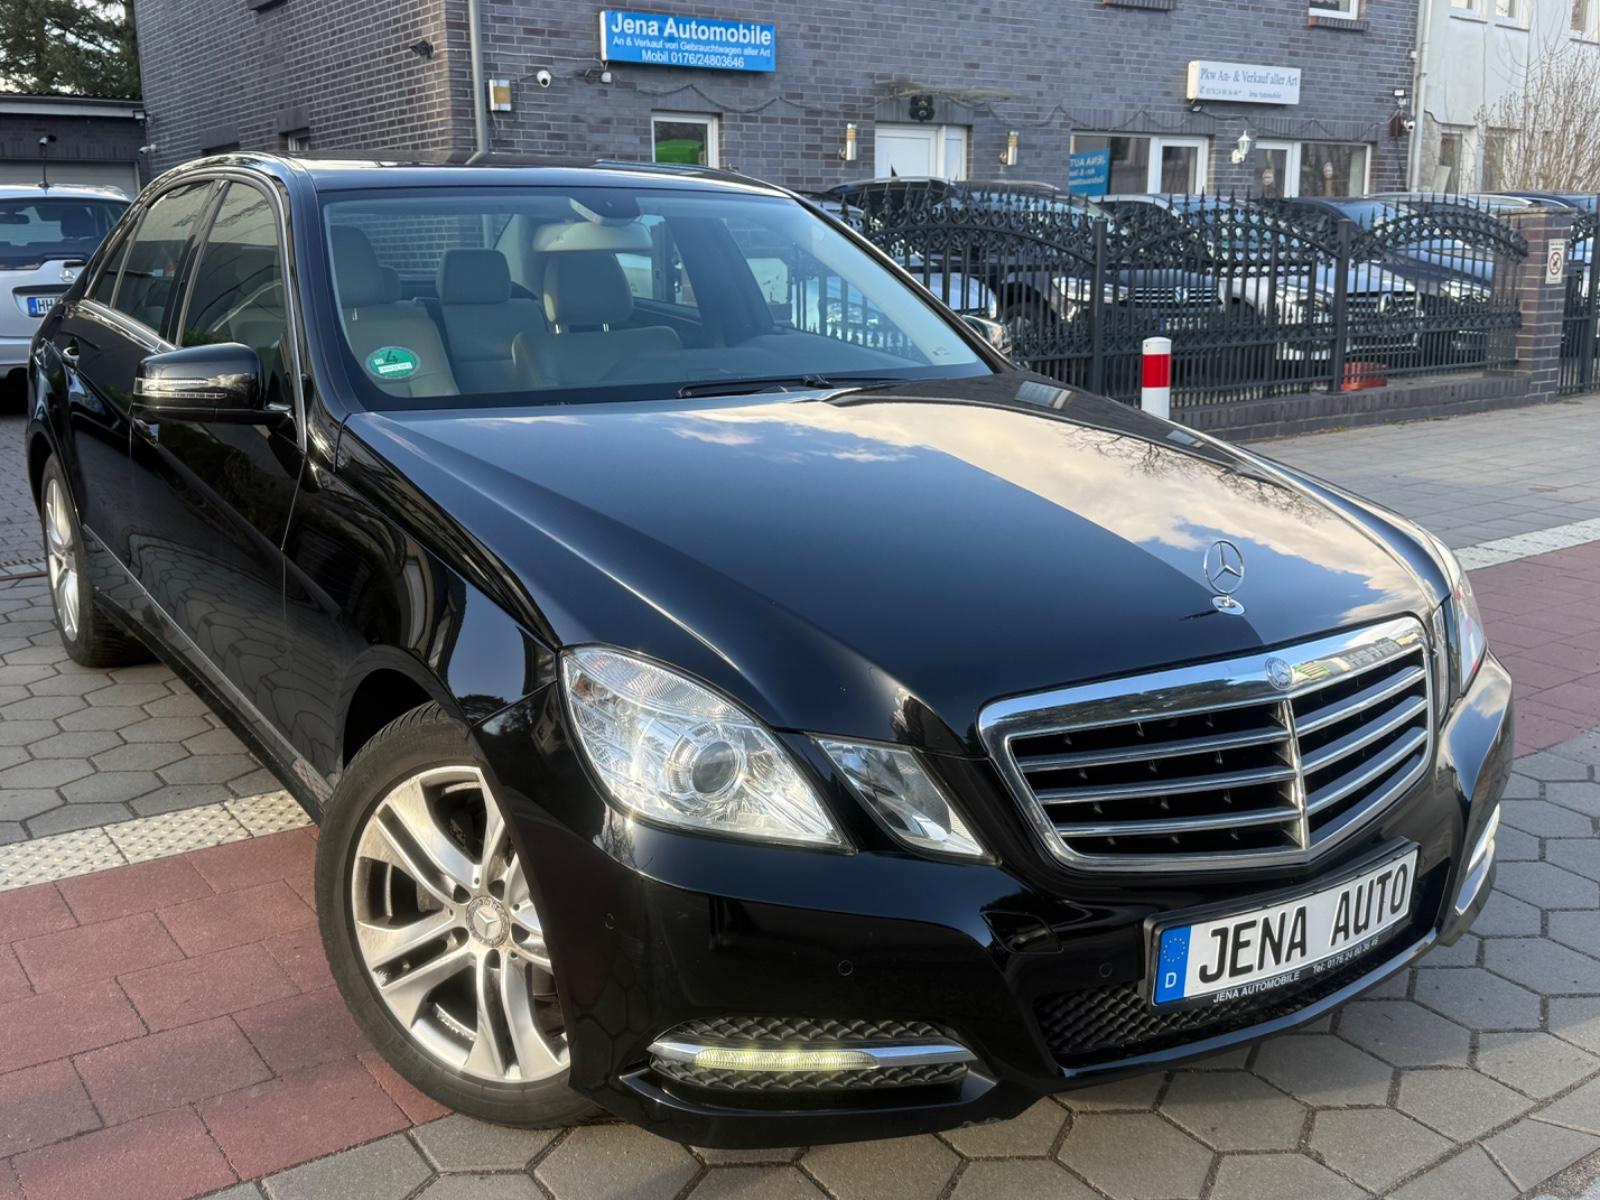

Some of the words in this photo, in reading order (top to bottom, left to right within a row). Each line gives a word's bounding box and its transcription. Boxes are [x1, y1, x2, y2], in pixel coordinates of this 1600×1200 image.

[611, 13, 659, 36] Jena
[664, 18, 771, 45] Automobile
[613, 37, 625, 46] An
[635, 38, 663, 49] Verkauf
[664, 41, 679, 50] von
[681, 42, 742, 56] Gebrauchtwagen
[743, 47, 758, 56] aller
[759, 48, 771, 57] Art
[641, 50, 669, 63] Mobil
[671, 53, 744, 68] 0176/24803646
[1233, 70, 1240, 82] &
[1242, 71, 1270, 84] Verkauf
[1270, 74, 1285, 85] aller
[1285, 75, 1298, 86] Art
[1198, 906, 1307, 984] JENA
[1330, 863, 1408, 947] AUTO
[1165, 972, 1176, 989] D
[1212, 989, 1240, 1004] JENA
[1240, 971, 1301, 998] AUTOMOBILE
